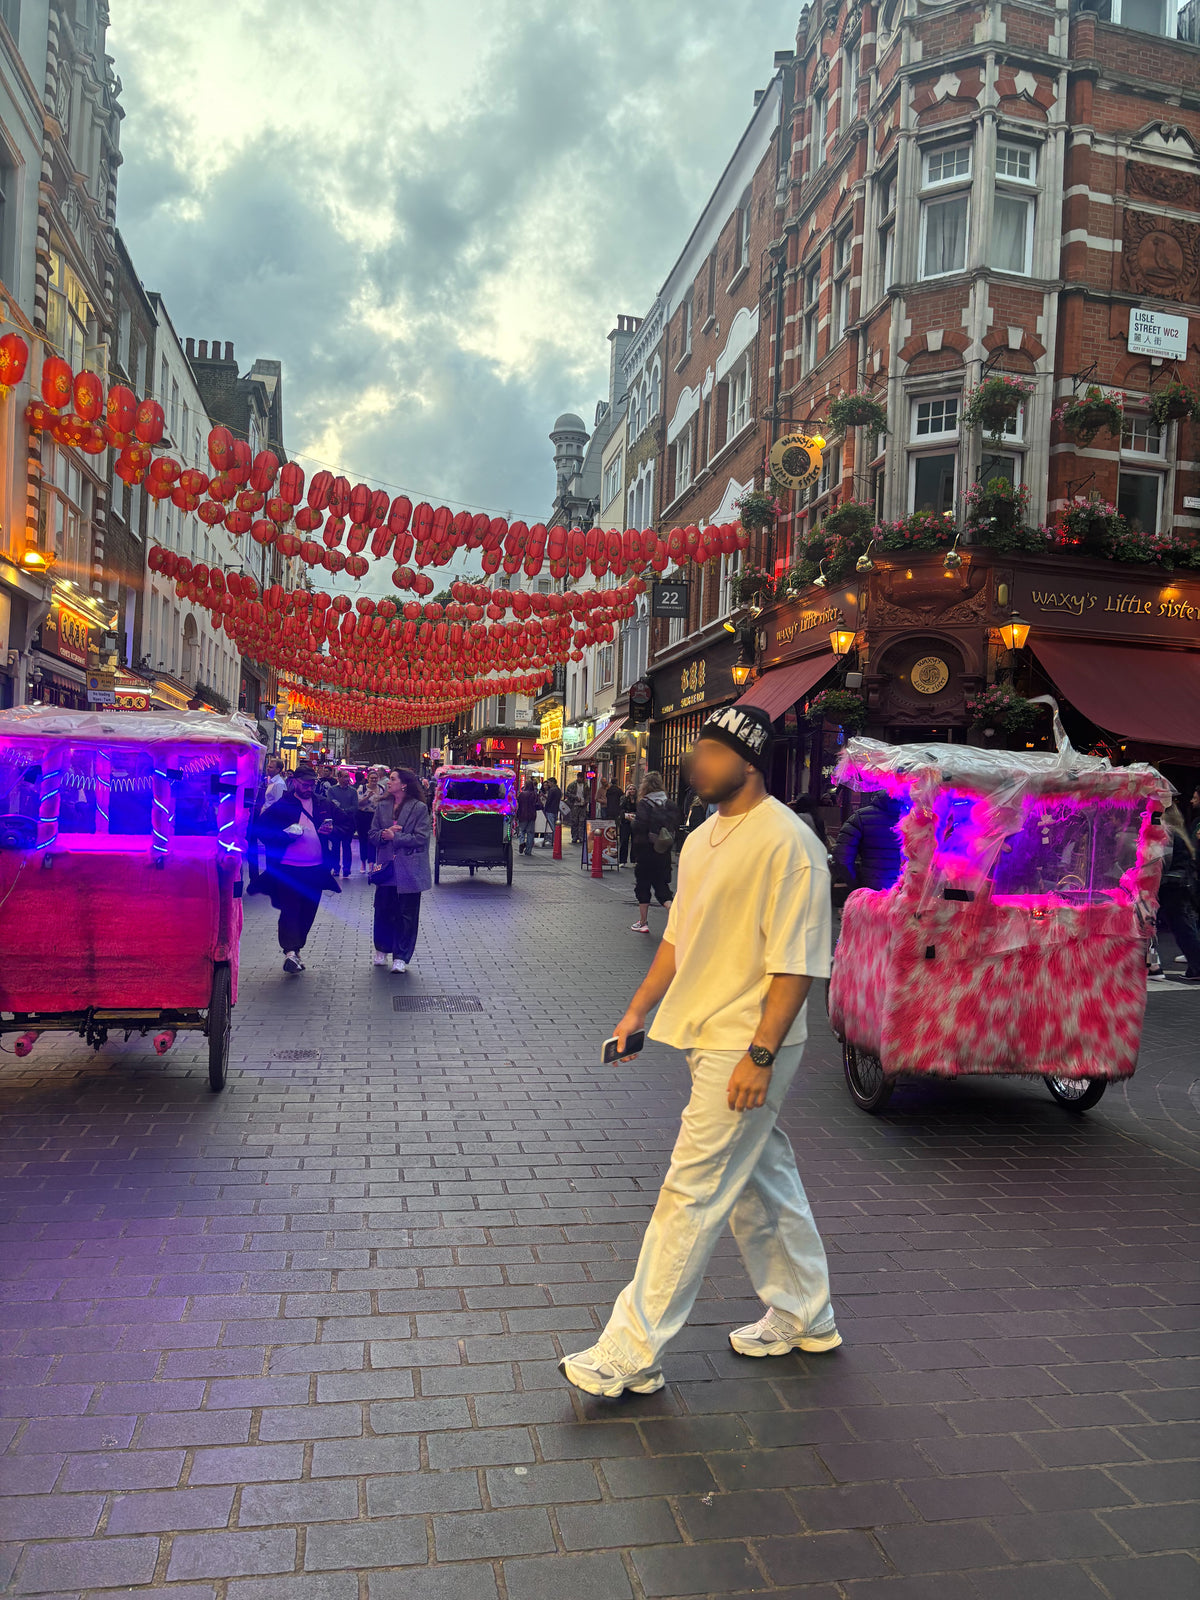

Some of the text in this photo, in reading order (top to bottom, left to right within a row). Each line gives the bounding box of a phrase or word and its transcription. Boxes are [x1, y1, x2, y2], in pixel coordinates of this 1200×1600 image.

[1135, 312, 1154, 323] LISLE
[1134, 323, 1179, 338] STREET WC2
[1146, 348, 1170, 356] WESTMINSTER
[661, 591, 679, 605] 22
